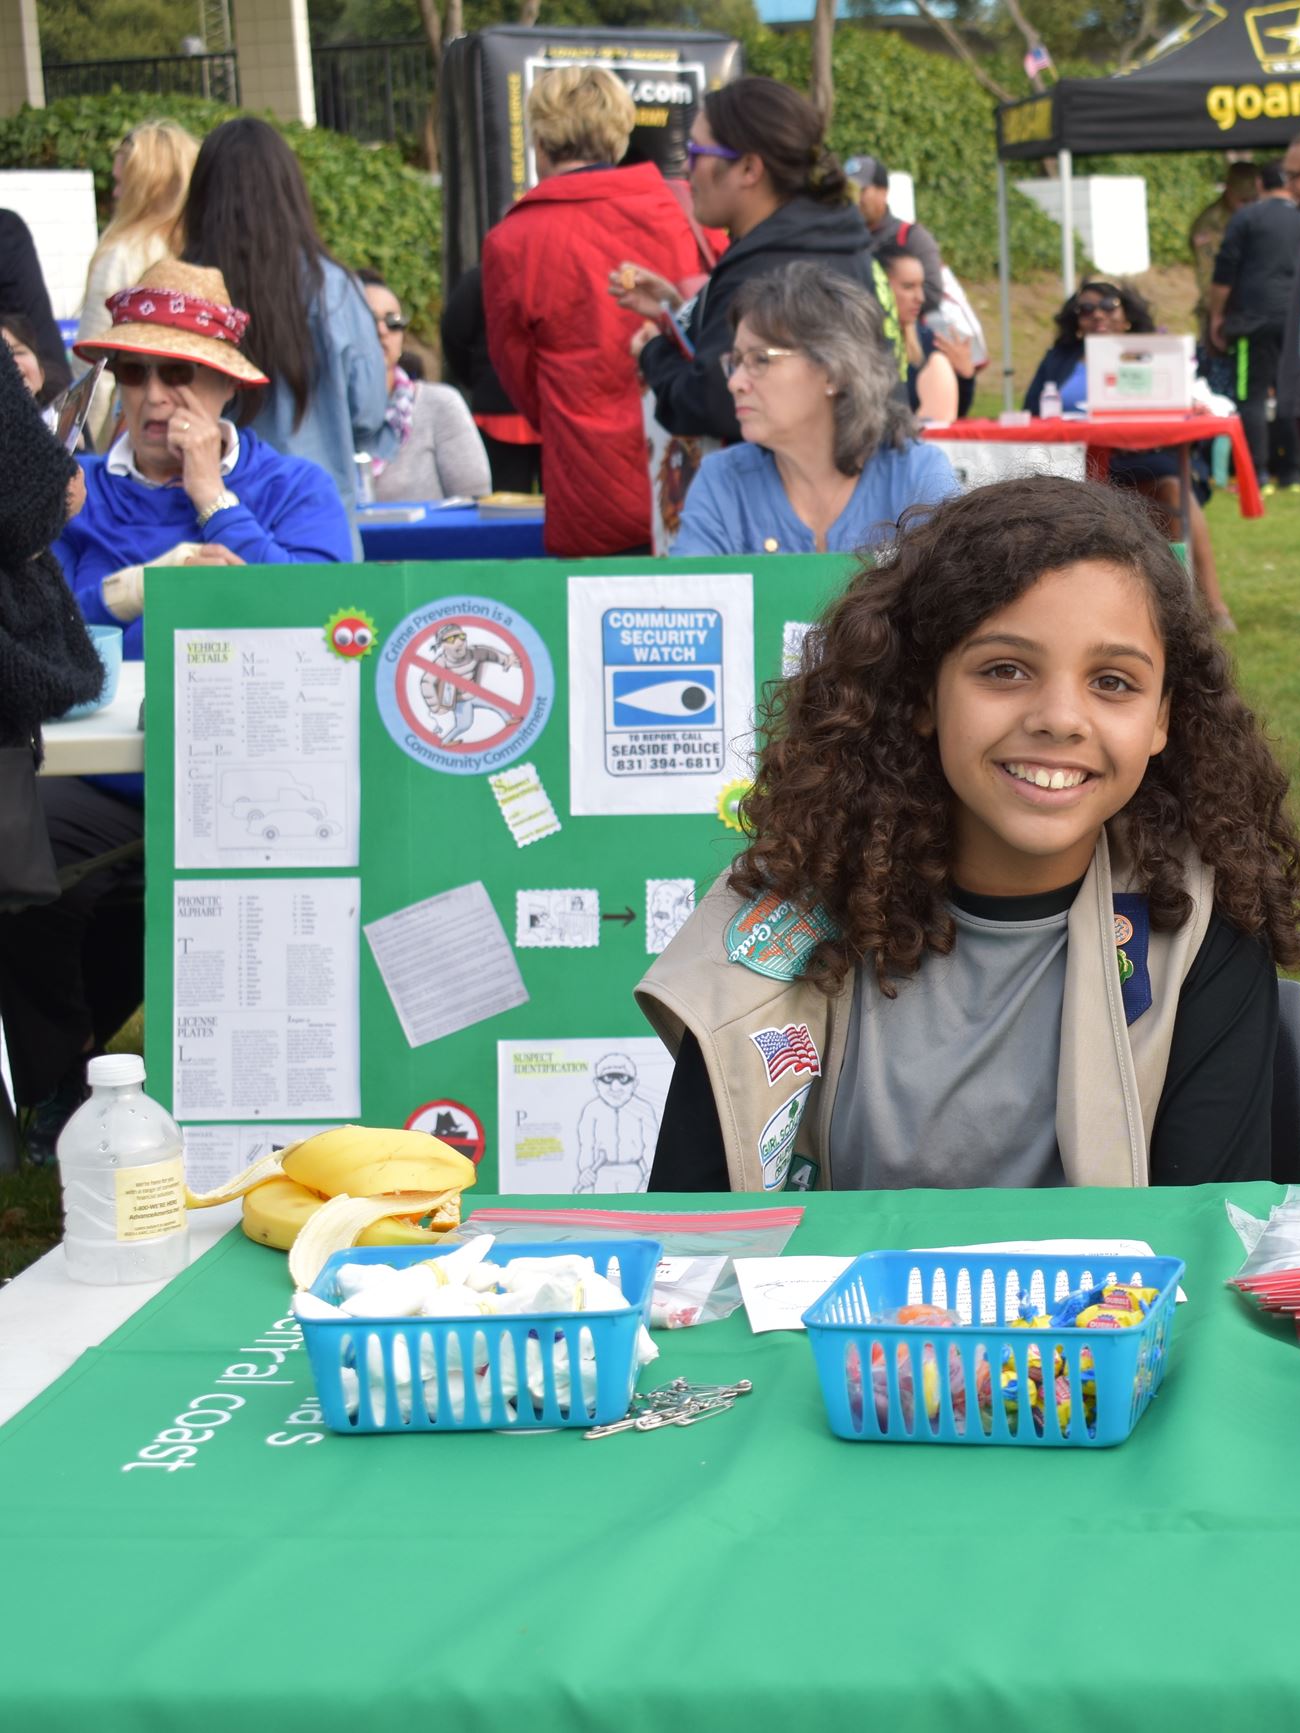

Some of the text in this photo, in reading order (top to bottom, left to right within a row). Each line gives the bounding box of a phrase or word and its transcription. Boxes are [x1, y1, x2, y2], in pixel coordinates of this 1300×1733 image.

[609, 612, 717, 628] COMMUNITY
[385, 602, 513, 663] Crime Prevention is a
[620, 630, 708, 645] SECURITY
[187, 642, 230, 653] VEHICLE
[187, 653, 229, 664] DETAILS
[633, 647, 696, 662] WATCH
[404, 696, 548, 771] Community Commitment
[682, 732, 702, 740] CALL
[612, 742, 720, 757] SEASIDE POLICE
[650, 757, 720, 770] 394-6811
[177, 896, 221, 907] PHONETIC
[177, 907, 224, 918] ALPHABET
[177, 1016, 218, 1027] LICENSE
[177, 1027, 214, 1038] PLATES
[513, 1052, 554, 1062] SUSPECT
[514, 1063, 588, 1074] IDENTIFICATION
[762, 1134, 780, 1156] GIRL
[791, 1164, 812, 1192] 4
